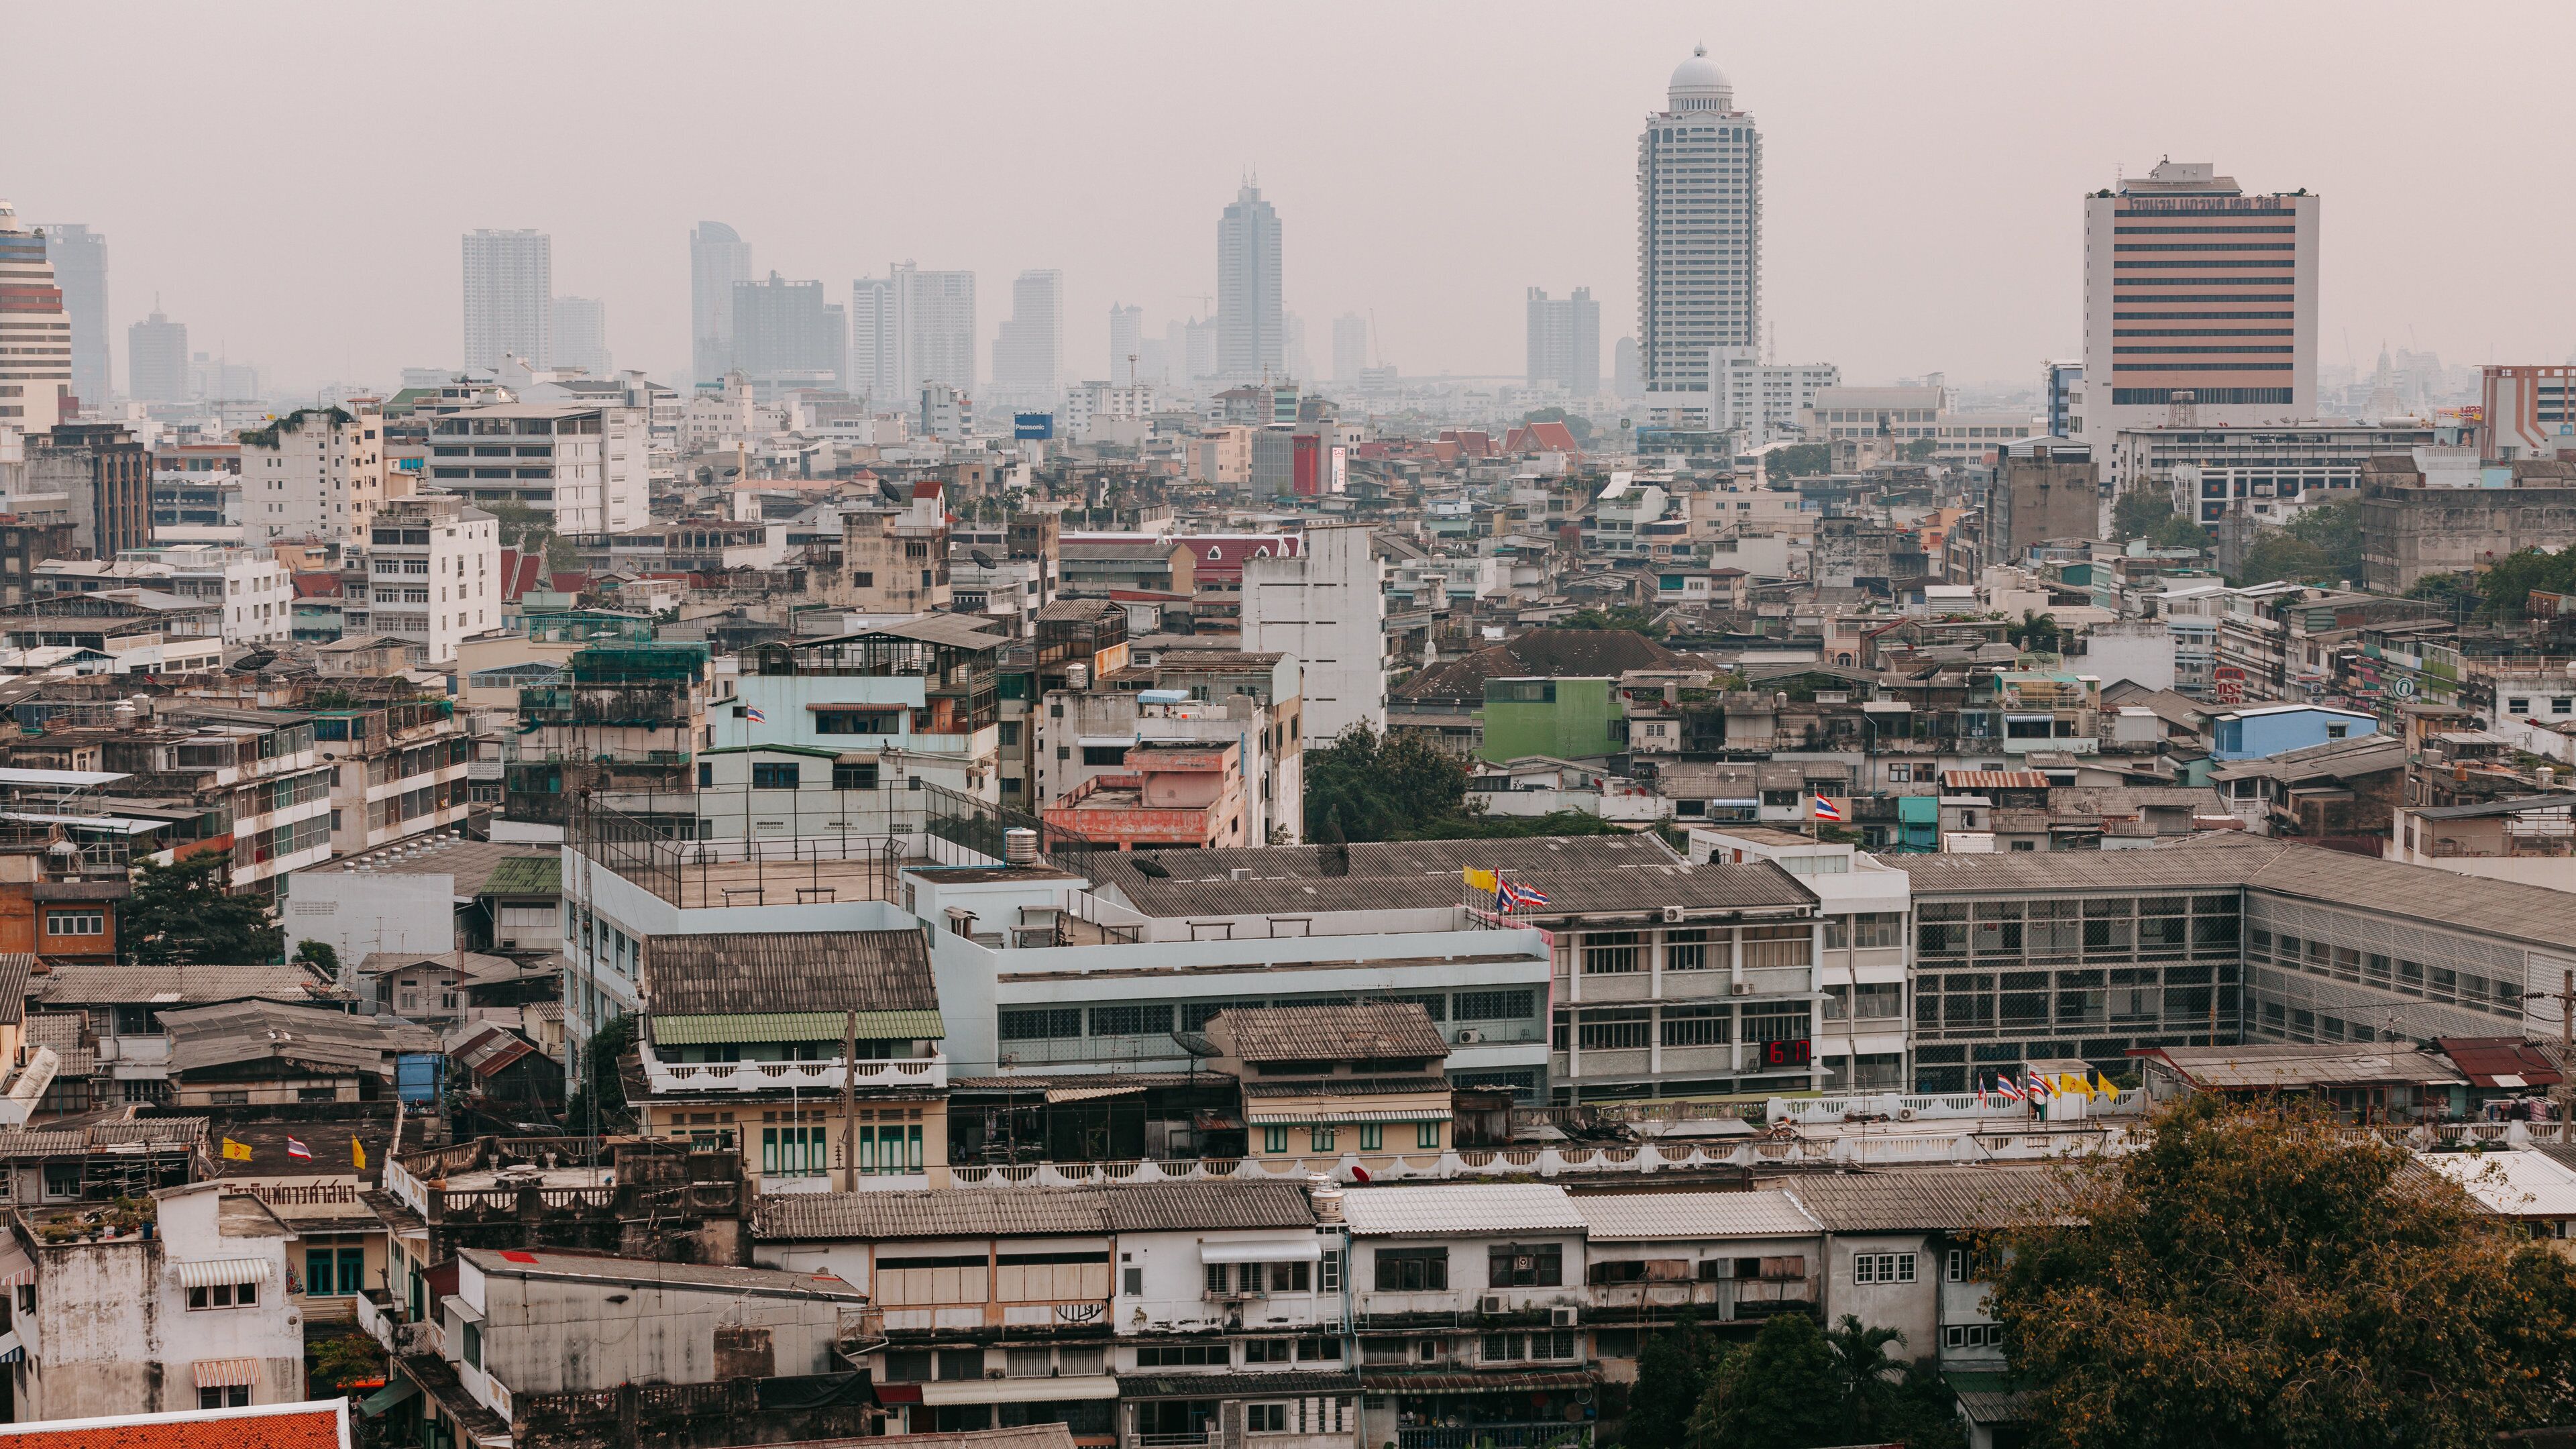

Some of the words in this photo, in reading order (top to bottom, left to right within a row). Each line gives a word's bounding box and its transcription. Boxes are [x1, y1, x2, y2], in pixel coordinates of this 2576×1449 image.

[2129, 196, 2176, 210] โรงแรม
[2218, 683, 2242, 695] กระ
[1771, 1042, 1783, 1063] 16
[1796, 1040, 1809, 1061] 17
